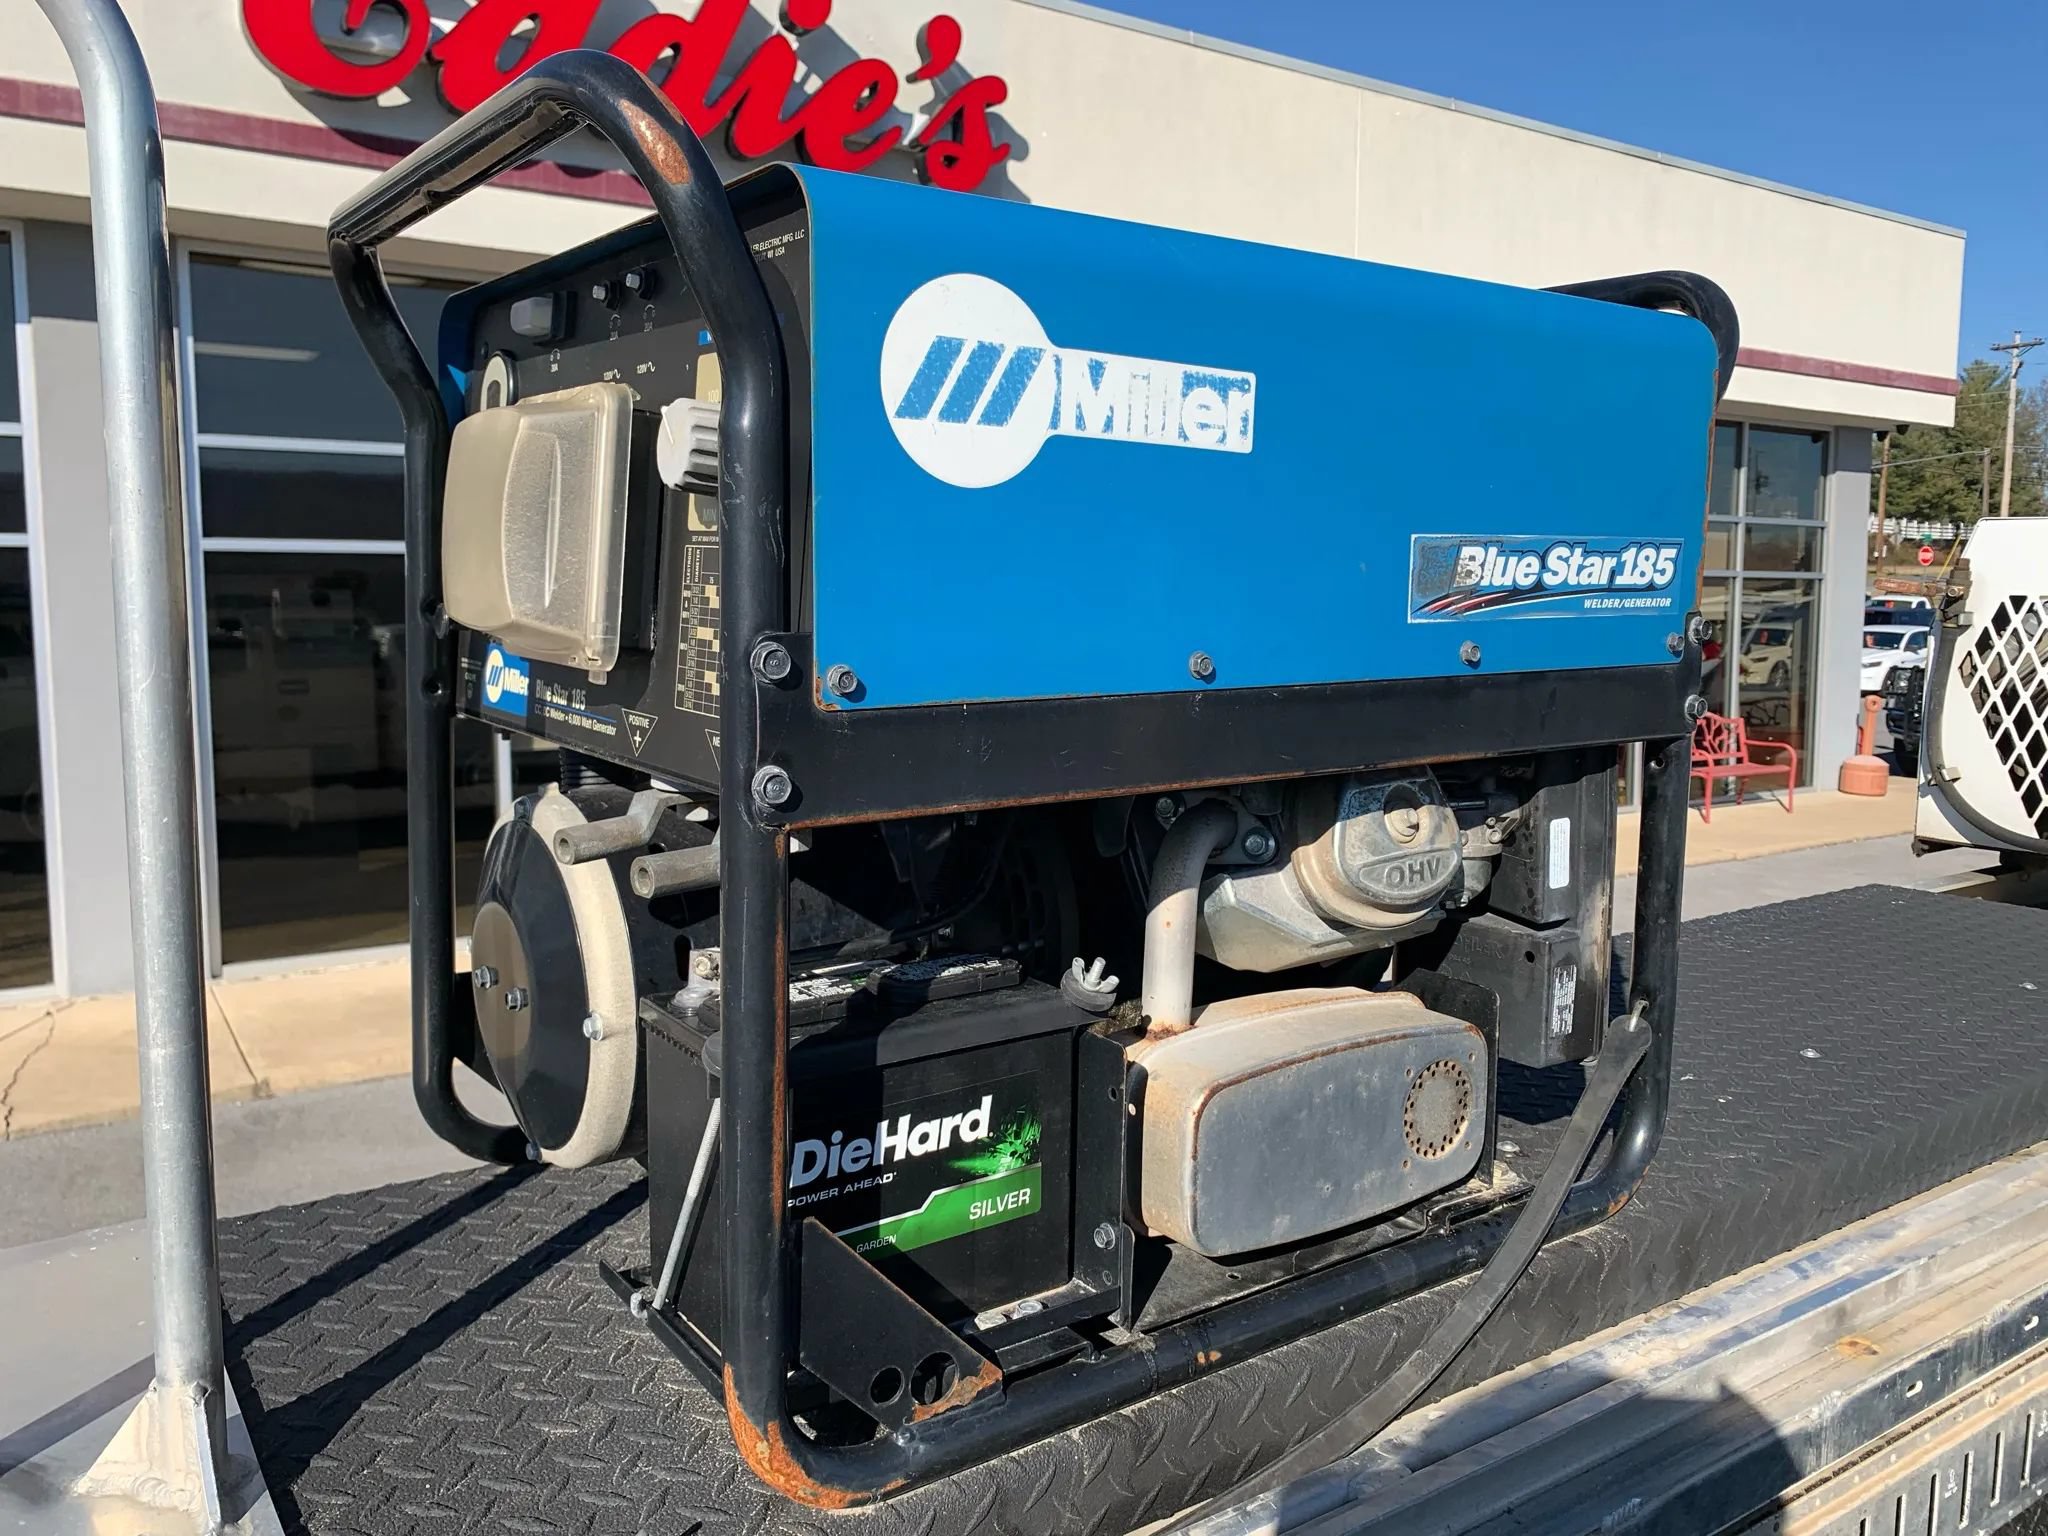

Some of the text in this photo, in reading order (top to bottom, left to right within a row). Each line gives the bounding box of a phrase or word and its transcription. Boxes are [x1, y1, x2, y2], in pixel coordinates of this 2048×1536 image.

[760, 236, 782, 251] ELECTRIC
[794, 228, 805, 240] LLC
[774, 246, 785, 256] USA
[1060, 353, 1252, 450] Miller
[1454, 546, 1678, 588] Blue Star 185
[1583, 597, 1673, 609] WELDER/GENERATOR
[504, 667, 529, 696] Miller
[536, 679, 586, 711] Blue Star 185
[550, 708, 566, 722] Welder
[582, 716, 592, 730] Watt
[592, 720, 617, 736] Generator
[628, 714, 650, 729] POSITIVE
[1384, 856, 1441, 888] OHV
[790, 1094, 994, 1188] DieHard
[787, 1173, 893, 1208] POWER AHEAD
[969, 1187, 1031, 1222] SILVER
[856, 1234, 897, 1255] GARDEN
